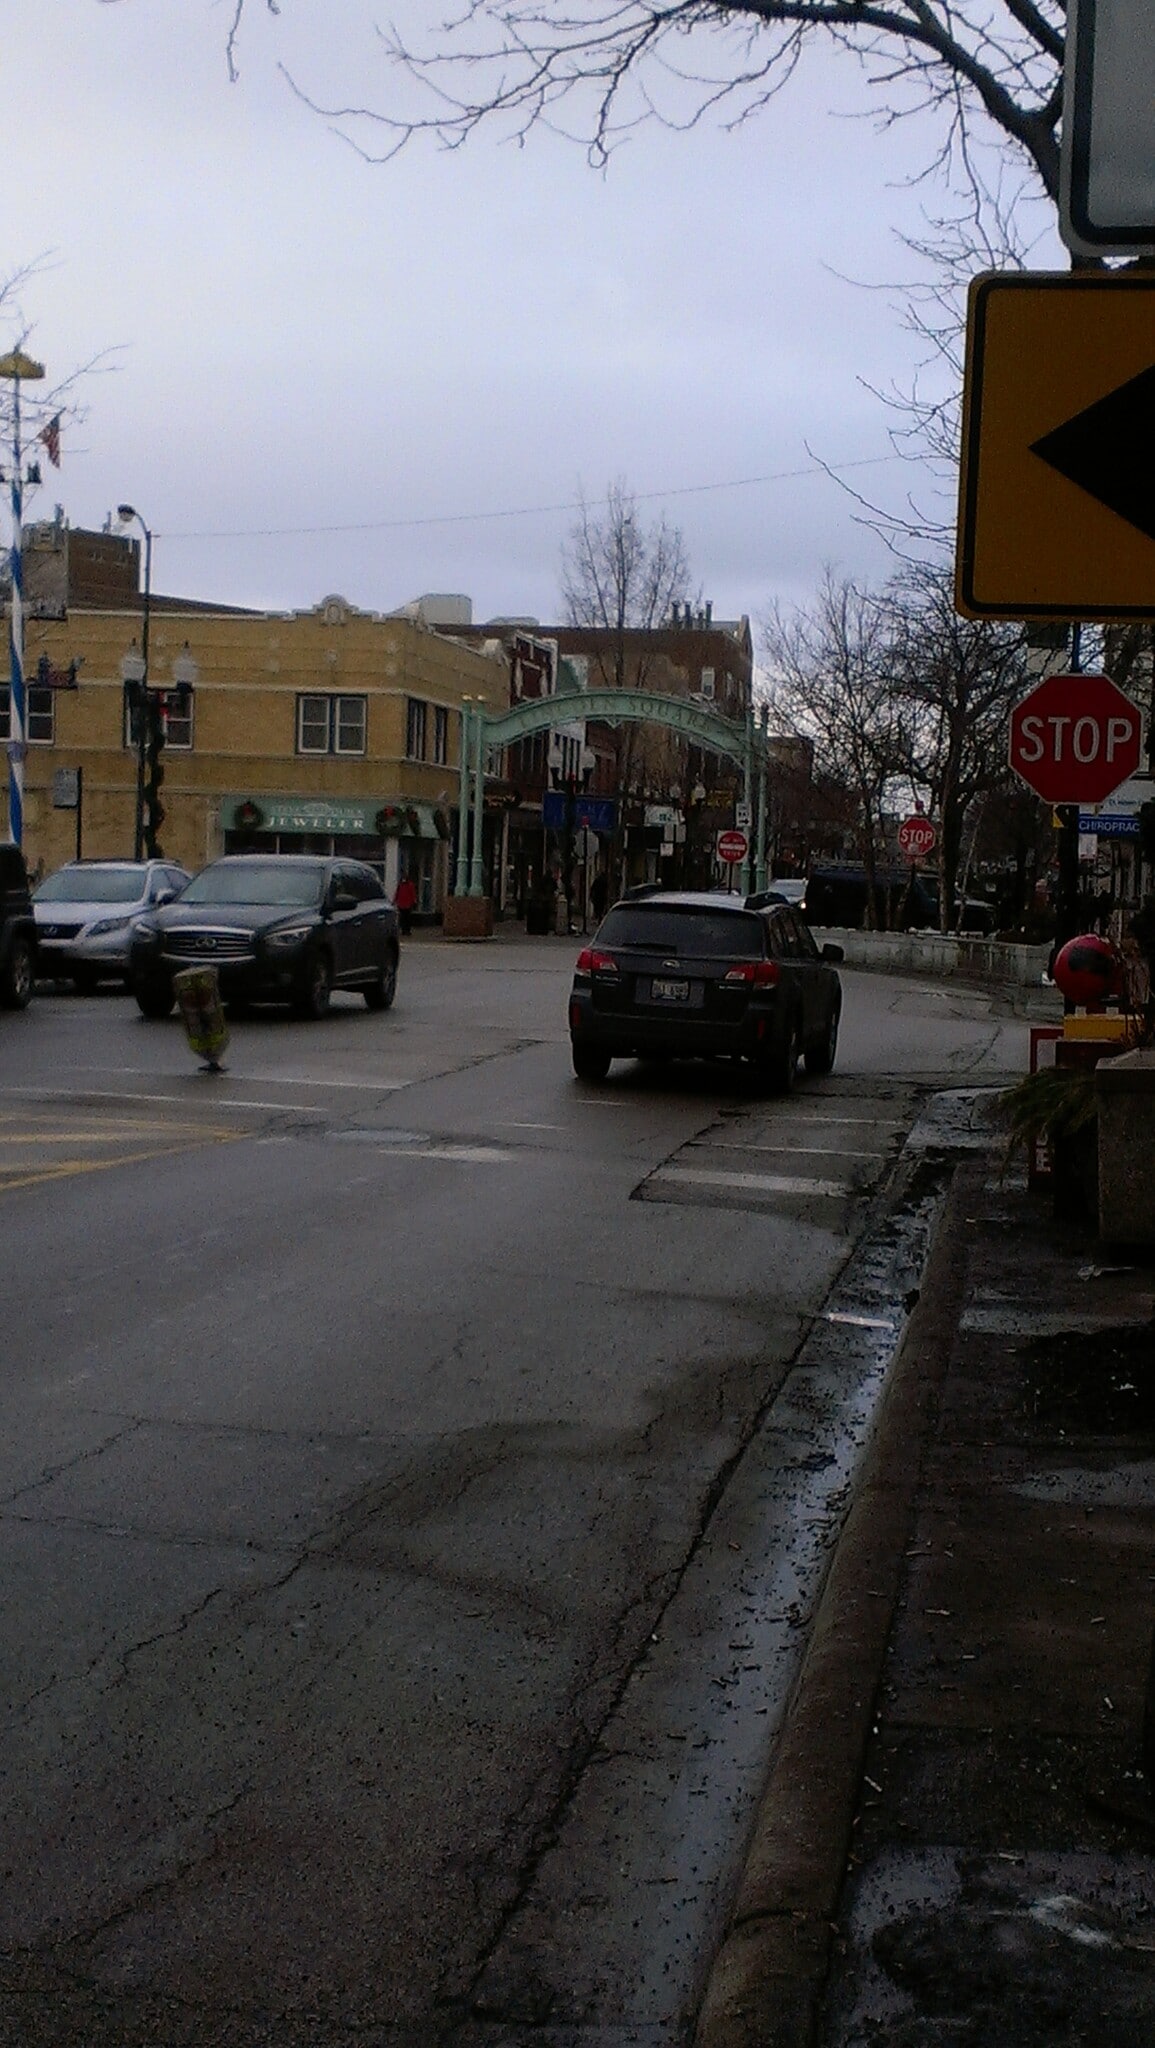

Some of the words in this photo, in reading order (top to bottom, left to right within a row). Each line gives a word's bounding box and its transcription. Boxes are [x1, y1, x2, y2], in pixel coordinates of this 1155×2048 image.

[628, 698, 711, 731] SQUARE
[1019, 715, 1133, 764] STOP
[266, 816, 364, 830] JEWELER
[900, 828, 933, 845] STOP
